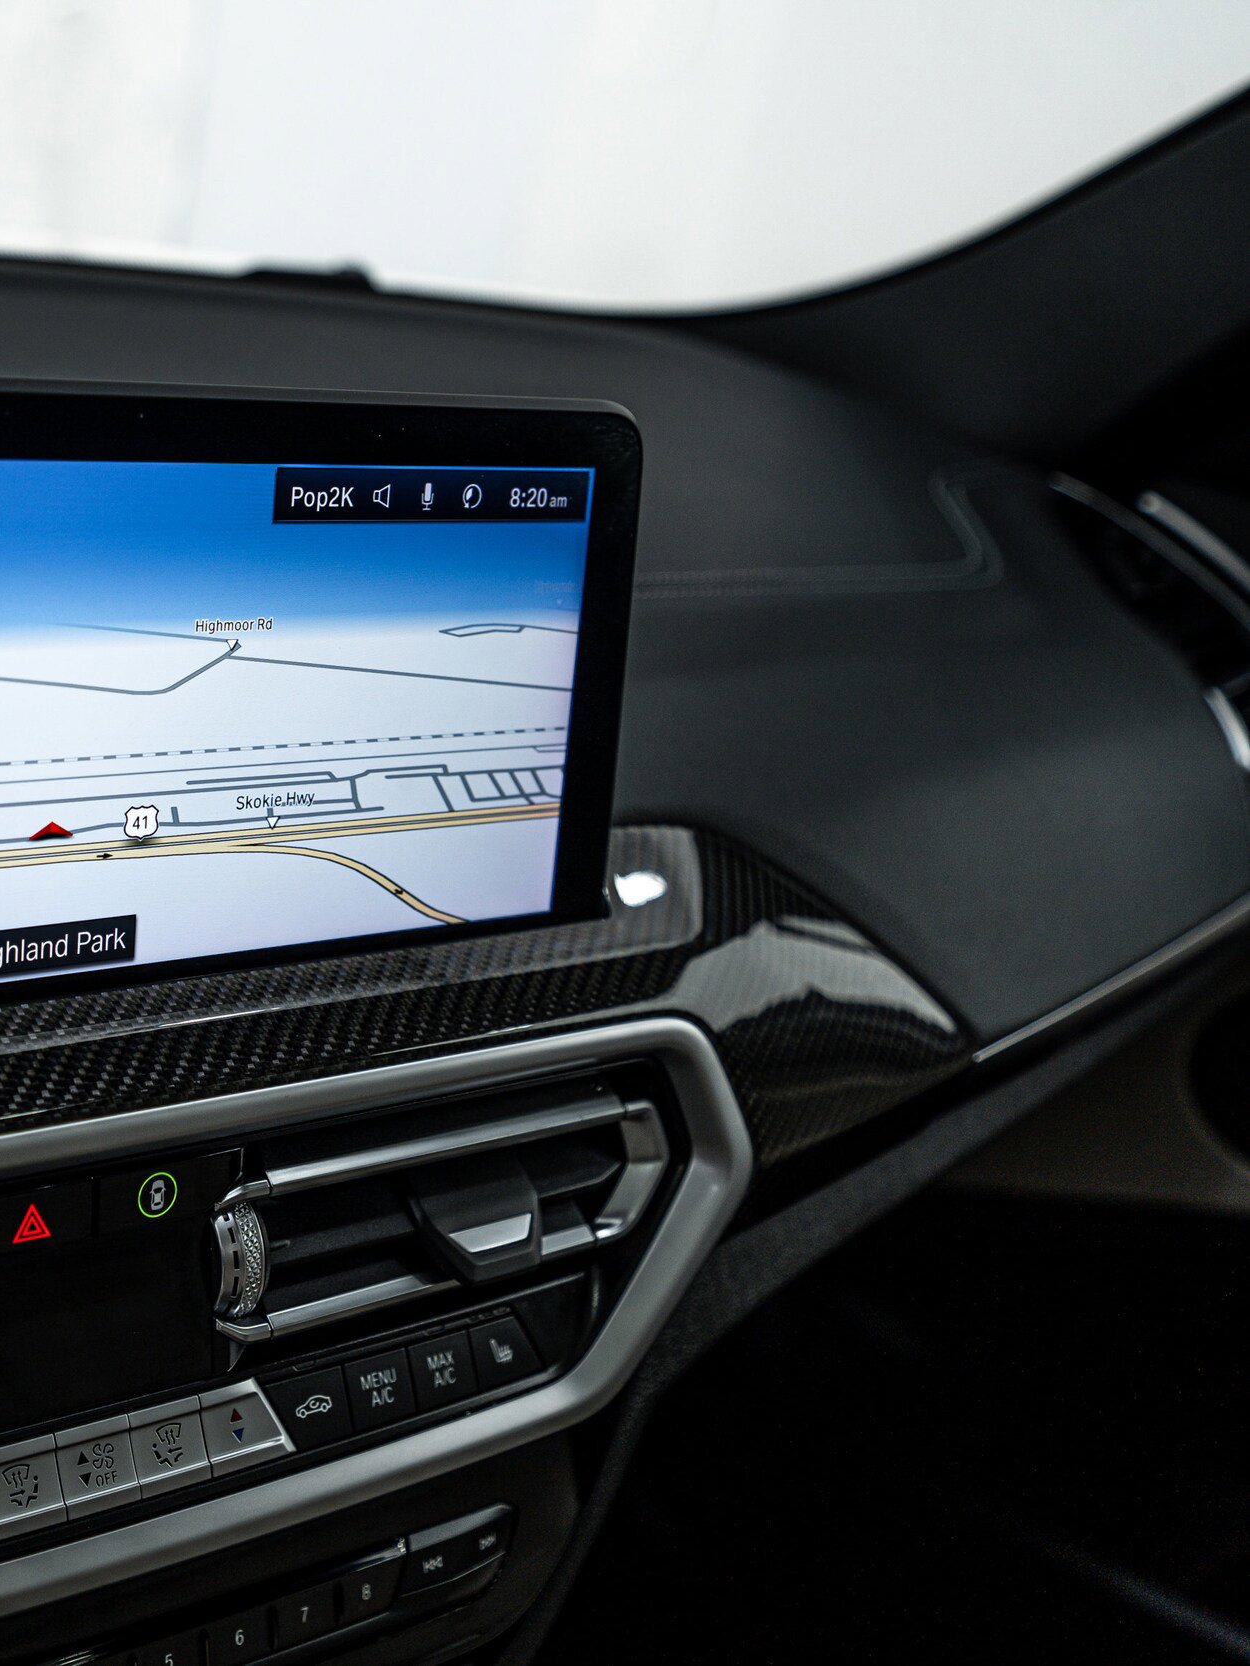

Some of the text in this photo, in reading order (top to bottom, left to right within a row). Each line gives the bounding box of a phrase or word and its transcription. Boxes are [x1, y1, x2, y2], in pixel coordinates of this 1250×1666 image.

[291, 486, 354, 512] Pop2K
[510, 487, 568, 508] 8:20 am
[195, 617, 274, 635] Highmoor Rd
[236, 791, 315, 810] Skokie Hwy
[132, 815, 149, 830] 41
[76, 927, 127, 955] Park
[426, 1350, 455, 1371] MAX
[359, 1367, 398, 1391] MENU
[433, 1367, 457, 1388] A/C
[371, 1386, 395, 1408] A/C
[95, 1470, 118, 1487] OFF
[361, 1583, 372, 1601] 8
[301, 1606, 310, 1623] 7
[234, 1629, 245, 1646] 6
[164, 1652, 174, 1666] 5
